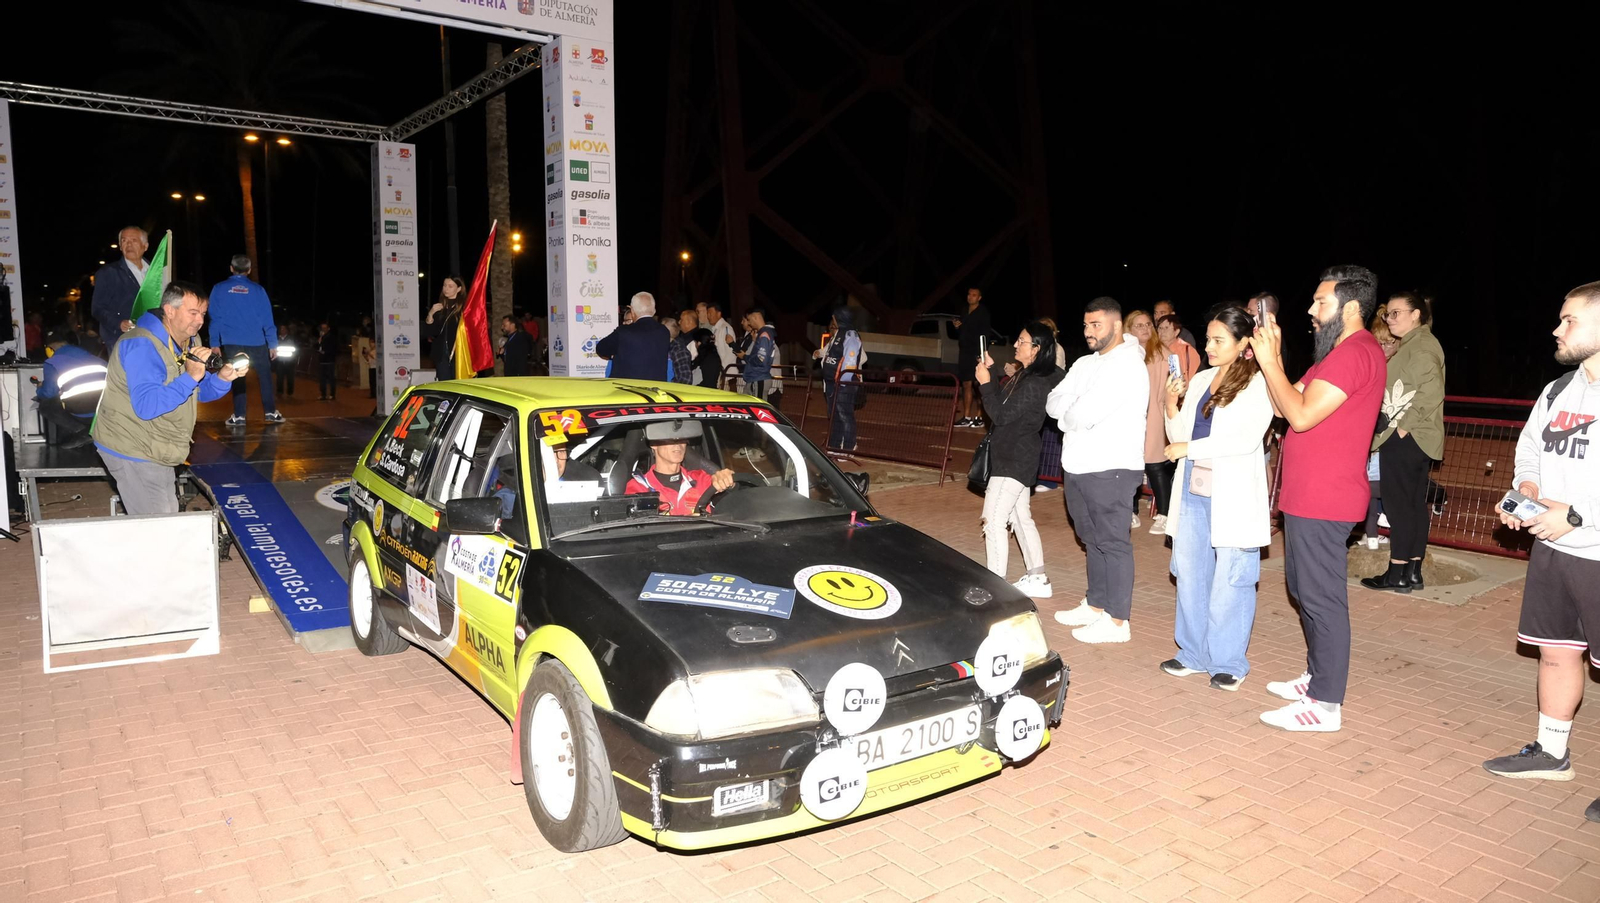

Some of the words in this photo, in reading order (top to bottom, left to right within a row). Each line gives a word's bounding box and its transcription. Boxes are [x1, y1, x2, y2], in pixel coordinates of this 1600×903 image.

[539, 8, 553, 17] DE
[554, 11, 597, 27] ALMERÍA
[570, 188, 611, 201] gasolia
[385, 239, 414, 247] gasolia
[572, 233, 611, 247] Phonika
[386, 267, 415, 277] Phonika
[393, 395, 424, 439] 52
[588, 404, 749, 419] CITROËN
[694, 412, 752, 420] SPORT
[539, 409, 589, 437] 52
[1550, 410, 1595, 431] JUST
[1544, 436, 1568, 456] DO
[496, 553, 521, 600] 52
[709, 574, 736, 584] 52
[655, 586, 697, 596] COSTA
[657, 579, 688, 589] 50
[687, 581, 780, 601] RALLYE
[465, 621, 507, 674] ALPHA
[851, 697, 881, 706] CIBIE
[900, 716, 955, 756] 2100
[966, 710, 978, 736] S
[1018, 723, 1041, 734] CIBIE
[722, 783, 763, 806] Hella
[827, 779, 860, 795] CIBIE
